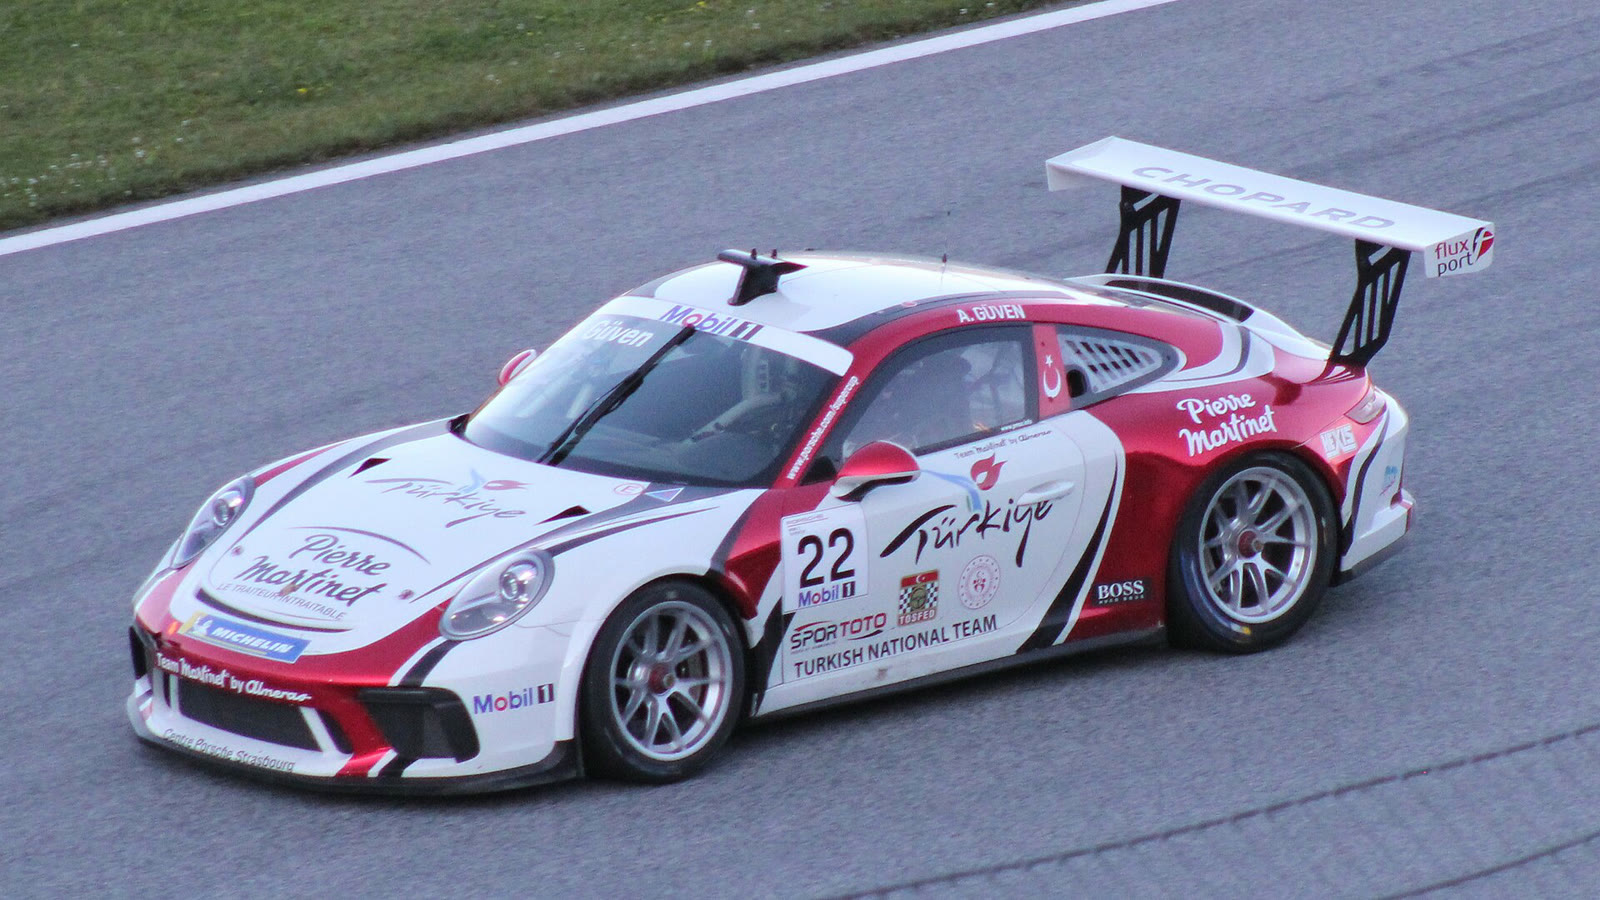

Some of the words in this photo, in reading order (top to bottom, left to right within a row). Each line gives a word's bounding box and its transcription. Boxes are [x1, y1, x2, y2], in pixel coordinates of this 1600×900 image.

[1132, 167, 1395, 229] CHOPARD
[1435, 239, 1469, 259] flux
[1438, 252, 1474, 277] port
[584, 319, 654, 347] Güven
[659, 304, 738, 337] Mobil
[728, 321, 765, 341] 1
[1176, 392, 1256, 424] Pierre
[1178, 404, 1278, 457] Martinet
[364, 477, 528, 528] Türkiye
[880, 498, 1053, 568] Türkiye
[288, 533, 391, 576] Pierre
[797, 527, 855, 588] 22
[233, 555, 388, 608] Martinet
[798, 588, 839, 607] Mobil
[842, 581, 856, 598] 1
[1098, 580, 1145, 600] BOSS
[215, 582, 231, 591] LE
[231, 583, 280, 600] TRAITEUR
[277, 591, 348, 620] INTRAITABLE
[899, 608, 936, 625] TOSFED
[212, 626, 296, 654] MICHELIN
[795, 647, 863, 678] TURKISH
[868, 627, 949, 659] NATIONAL
[953, 614, 998, 637] TEAM
[157, 652, 179, 673] Team
[230, 676, 244, 693] by
[245, 680, 312, 702] Almeras
[473, 687, 534, 714] Mobil
[538, 683, 555, 705] 1
[164, 728, 194, 749] Centre
[195, 738, 234, 761] Porsche
[236, 750, 295, 774] Strasbourg
